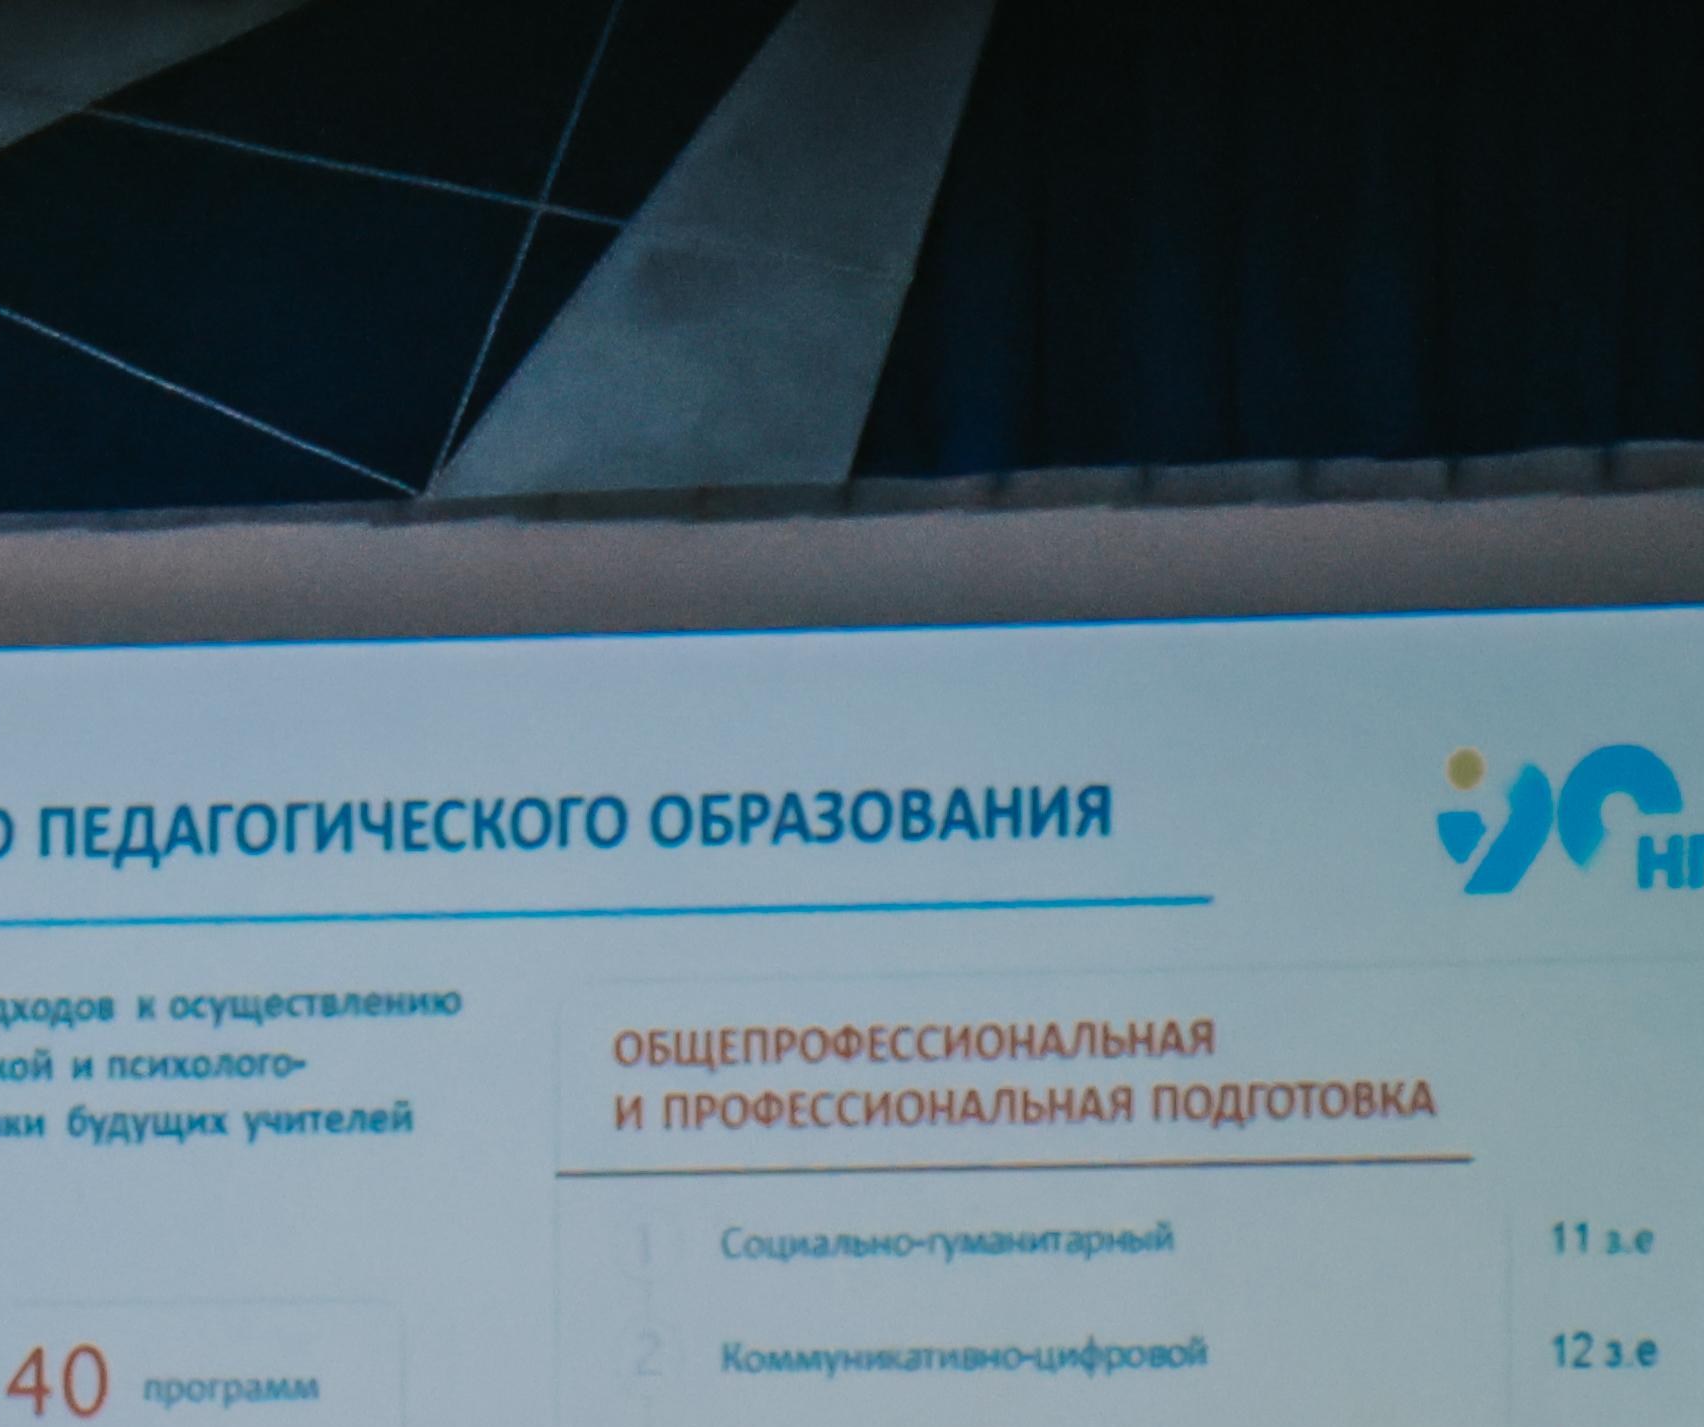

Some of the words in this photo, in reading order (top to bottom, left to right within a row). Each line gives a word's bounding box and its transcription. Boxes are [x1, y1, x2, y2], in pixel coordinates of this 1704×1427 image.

[38, 794, 629, 871] ПЕДАГОГИЧЕСКОГО
[648, 784, 1113, 850] ОБРАЗОВАНИЯ
[136, 996, 156, 1021] к
[168, 991, 463, 1029] осуществлению
[71, 1057, 94, 1081] и
[106, 1052, 308, 1082] психолого-
[612, 1017, 1215, 1073] ОБЩЕПРОФЕССИОНАЛЬНАЯ
[66, 1105, 229, 1146] будущих
[243, 1100, 415, 1145] учителей
[614, 1094, 644, 1130] И
[662, 1084, 1134, 1130] ПРОФЕССИОНАЛЬНАЯ
[1151, 1078, 1437, 1130] ПОДГОТОВКА
[720, 1220, 1176, 1264] Социально-гуманитарный
[1552, 1220, 1590, 1255] 11
[1605, 1229, 1655, 1256] з.е
[721, 1336, 1209, 1379] Коммуникативно-цифровой
[1552, 1330, 1594, 1370] 12
[1605, 1339, 1659, 1370] з.е
[5, 1342, 109, 1419] 40
[142, 1377, 321, 1411] программ
